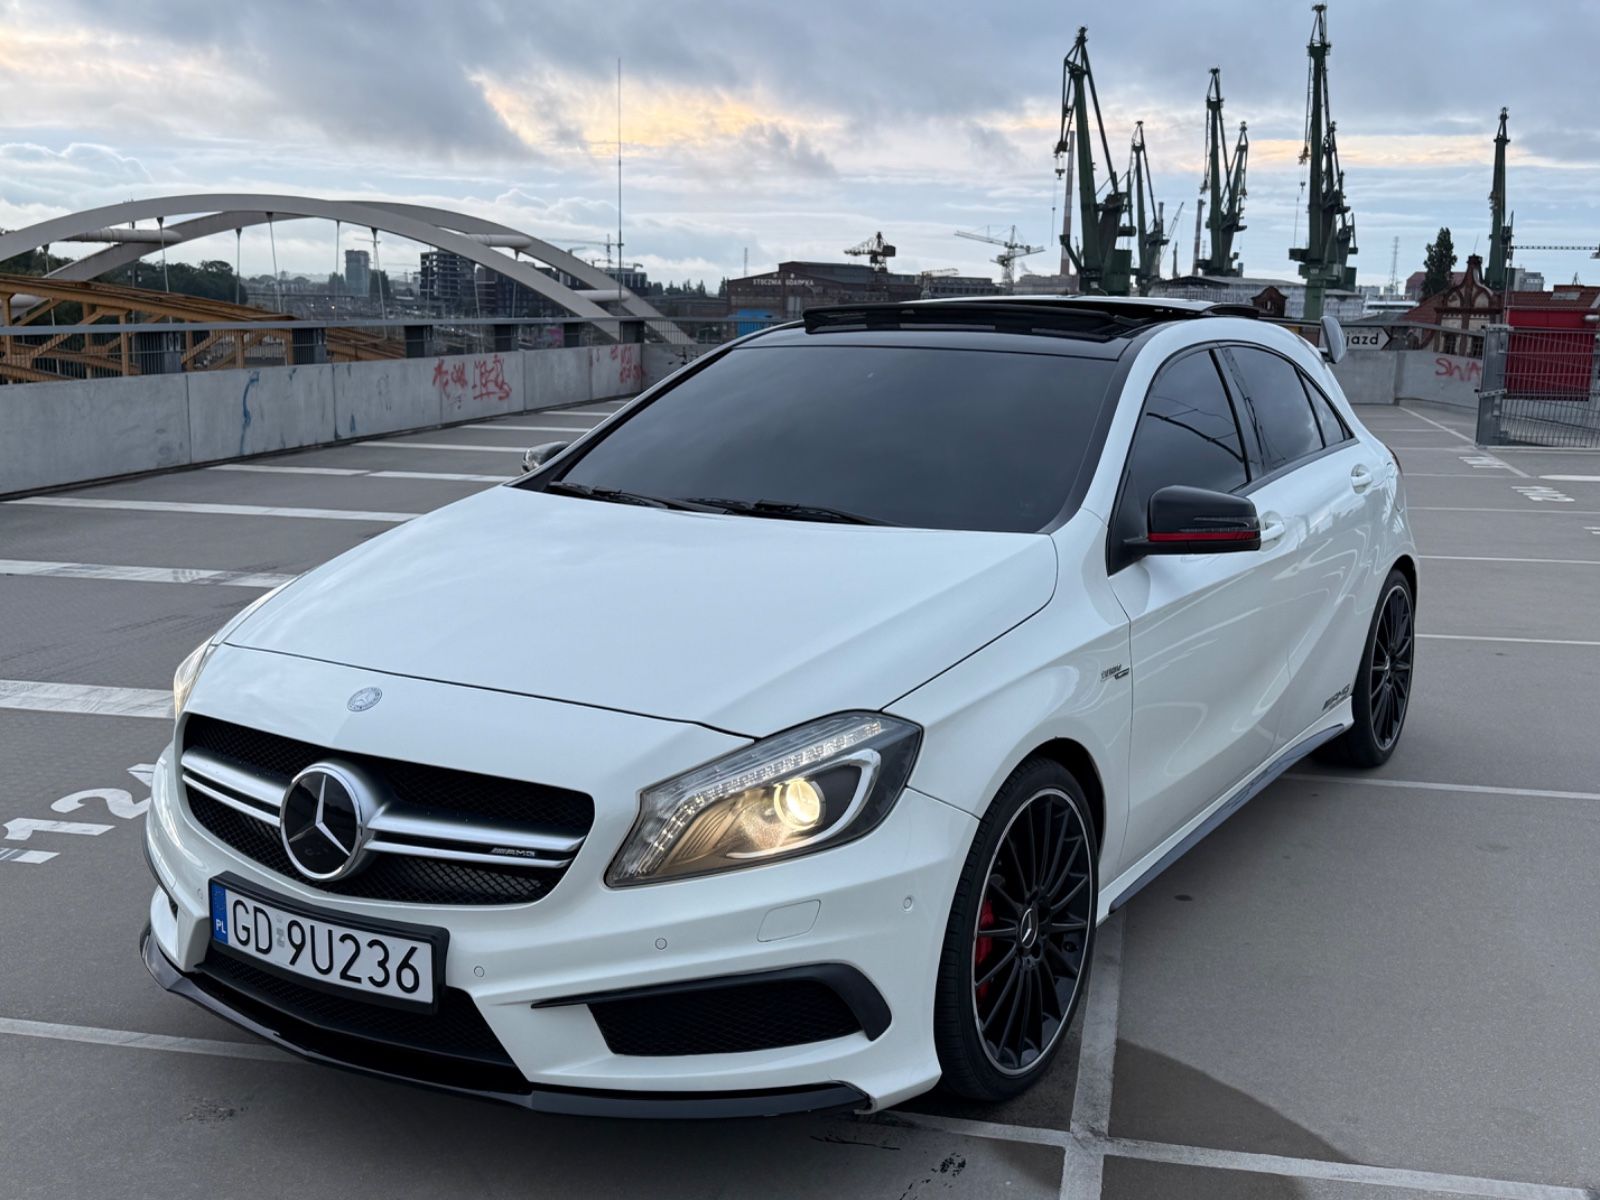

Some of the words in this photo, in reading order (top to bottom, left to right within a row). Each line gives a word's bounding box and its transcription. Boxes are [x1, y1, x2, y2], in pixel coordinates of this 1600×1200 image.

[1346, 331, 1379, 348] jazd
[215, 918, 226, 934] PL
[233, 899, 273, 955] GD
[287, 919, 420, 994] 9U236
